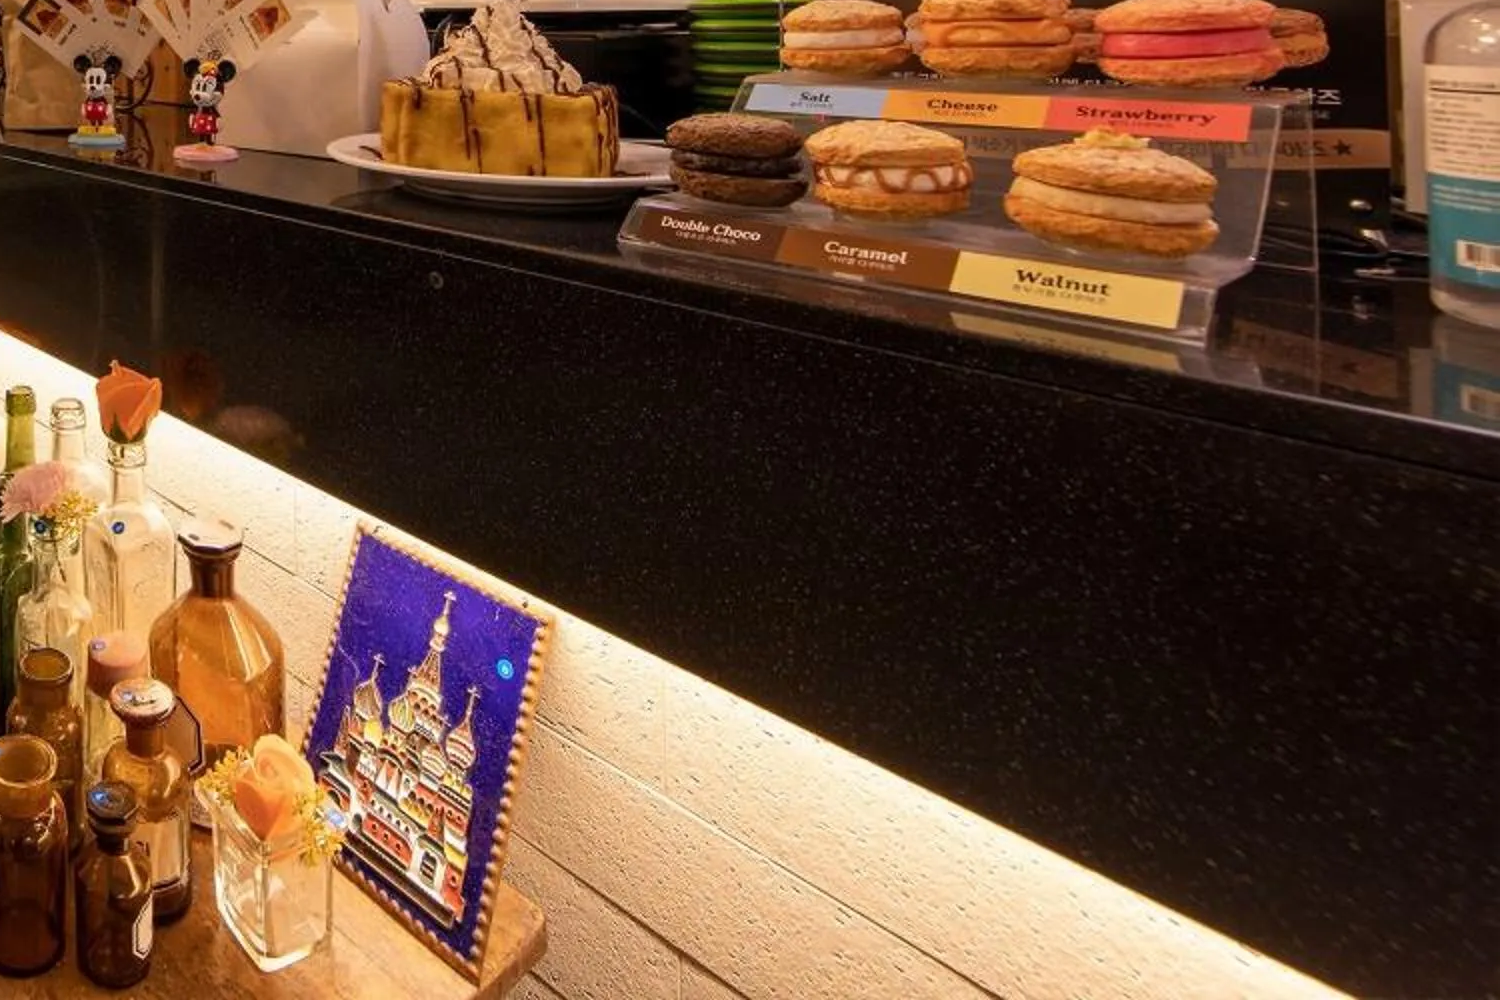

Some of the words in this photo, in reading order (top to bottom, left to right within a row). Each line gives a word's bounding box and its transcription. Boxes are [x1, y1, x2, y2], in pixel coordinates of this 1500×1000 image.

[800, 91, 831, 103] Salt
[927, 99, 999, 112] Cheese
[1076, 105, 1217, 126] Strawberry
[661, 215, 711, 233] Double
[713, 223, 762, 242] Choco
[824, 241, 909, 266] Caramel
[1015, 269, 1112, 297] Walnut
